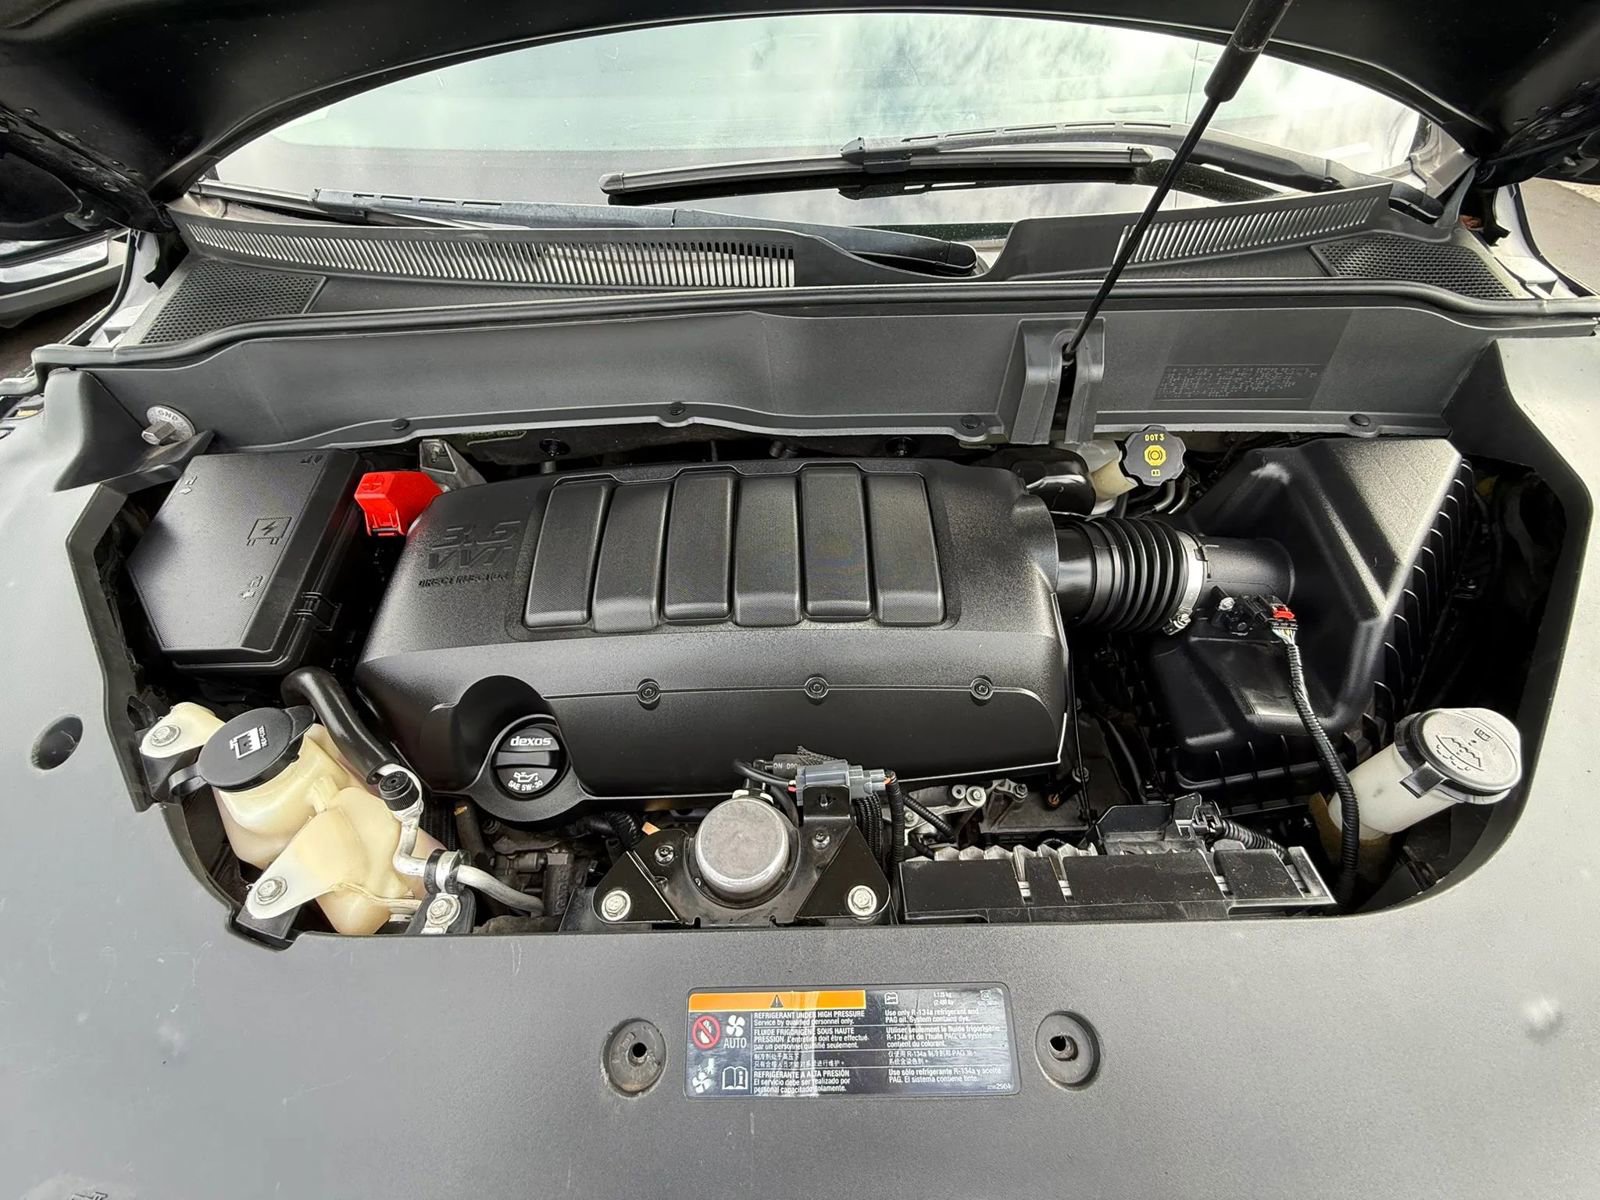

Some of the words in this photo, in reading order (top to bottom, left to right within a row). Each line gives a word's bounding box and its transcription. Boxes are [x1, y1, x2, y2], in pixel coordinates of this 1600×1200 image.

[510, 736, 554, 746] dexos
[508, 780, 521, 791] SAE
[521, 780, 544, 791] 5W-30
[898, 1009, 910, 1017] only
[934, 1008, 966, 1016] refrigerant
[776, 1019, 784, 1027] by
[786, 1018, 810, 1026] qualified
[812, 1018, 840, 1026] personnel
[840, 1018, 854, 1026] only.
[724, 1037, 746, 1048] AUTO
[774, 1043, 802, 1051] personnel
[754, 1070, 800, 1078] REFRIGERANTE
[822, 1068, 850, 1077] PRESIÓN
[902, 1068, 914, 1076] sólo
[916, 1068, 952, 1076] refrigerante
[780, 1086, 812, 1094] capacitado
